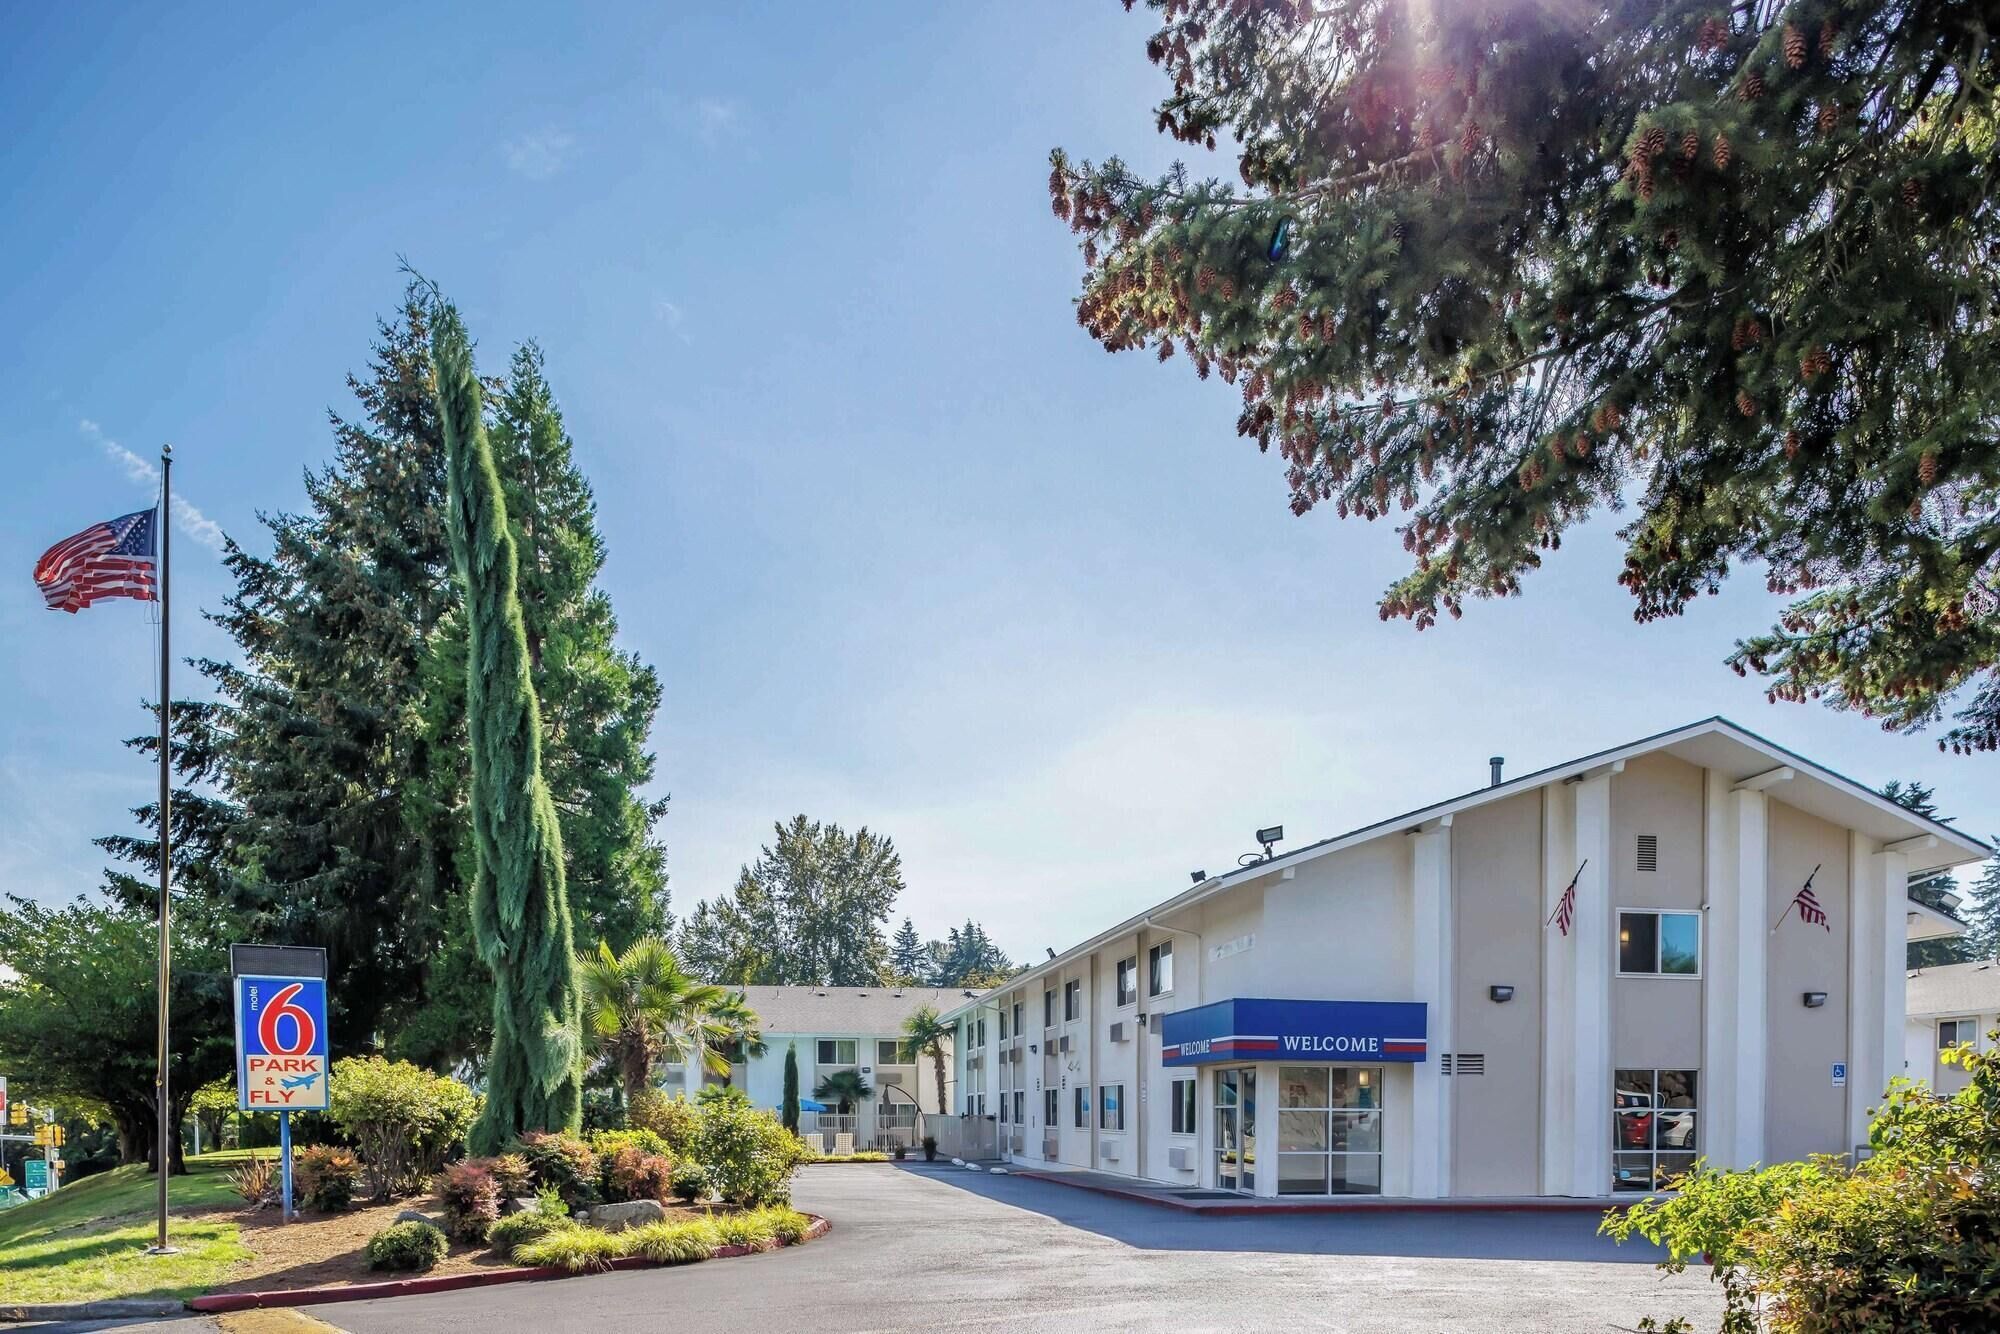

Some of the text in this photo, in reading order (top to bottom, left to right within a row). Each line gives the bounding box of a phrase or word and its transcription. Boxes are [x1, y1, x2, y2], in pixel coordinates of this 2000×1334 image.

[249, 983, 316, 1056] motel 6
[1180, 1039, 1210, 1057] WELCOME
[1283, 1035, 1379, 1052] WELCOME
[250, 1059, 318, 1072] PARK
[264, 1077, 275, 1086] &
[250, 1090, 295, 1104] FLY
